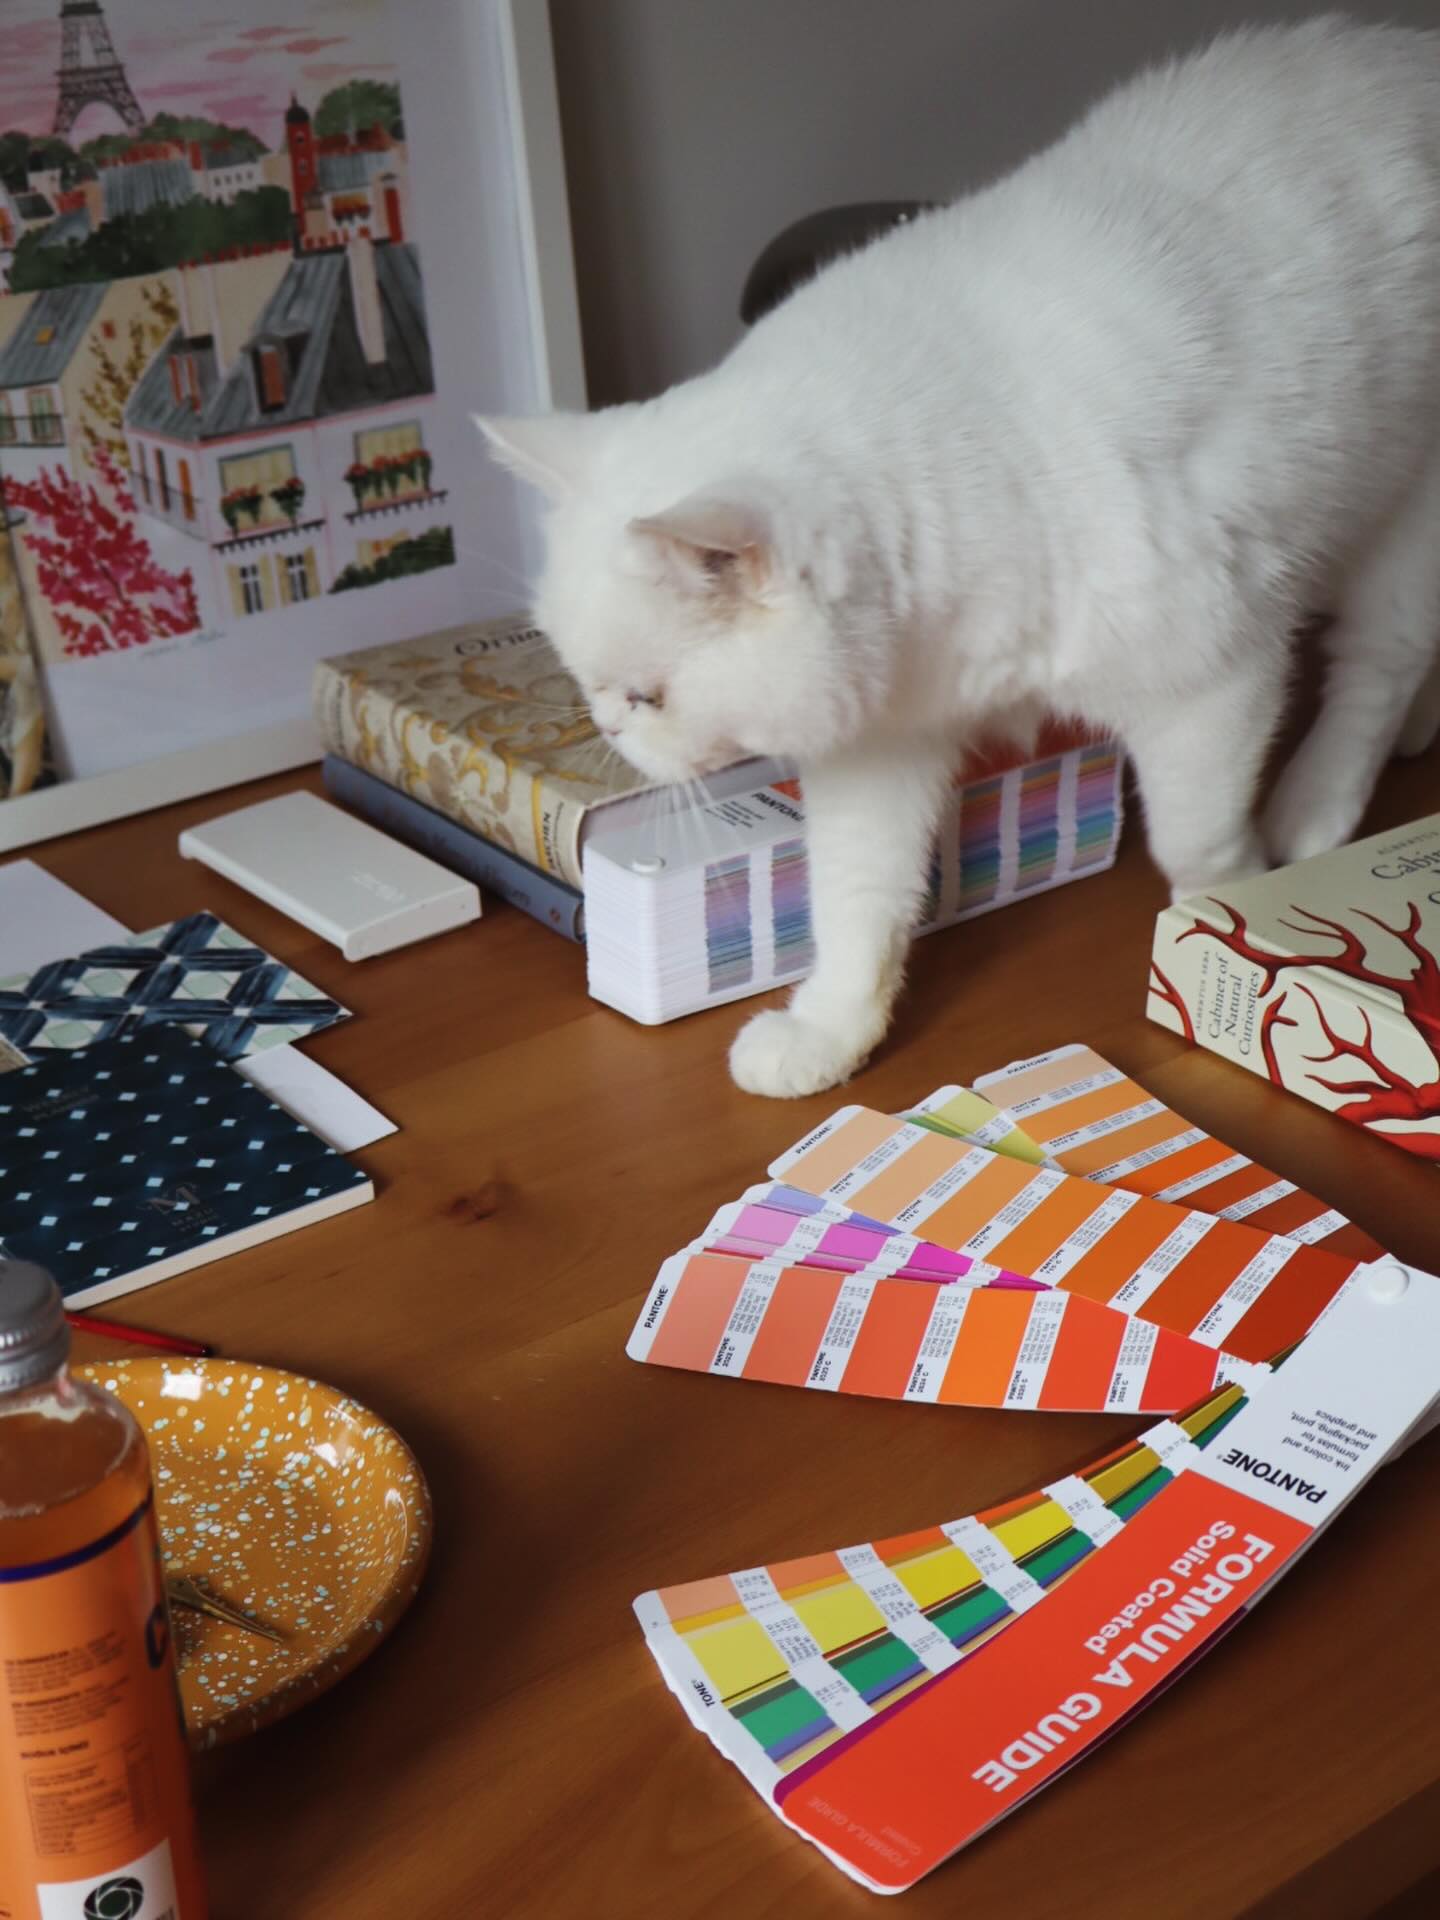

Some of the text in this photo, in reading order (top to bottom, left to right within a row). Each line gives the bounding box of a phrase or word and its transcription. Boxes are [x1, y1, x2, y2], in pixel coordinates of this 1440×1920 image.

[1208, 977, 1228, 1039] Cabinet
[1225, 975, 1243, 1037] Natural
[1239, 970, 1260, 1056] Curiosities
[796, 1124, 833, 1154] PANTONE
[644, 1285, 667, 1329] PANTONE
[1290, 1412, 1369, 1450] packaging, print,
[1300, 1431, 1359, 1461] formulas for
[1315, 1410, 1377, 1440] and graphics
[1221, 1447, 1327, 1504] PANTONE
[1281, 1436, 1351, 1472] Ink colors and
[1083, 1519, 1236, 1655] Solid Coated
[1093, 1533, 1275, 1689] FORMULA
[971, 1691, 1103, 1793] GUIDE
